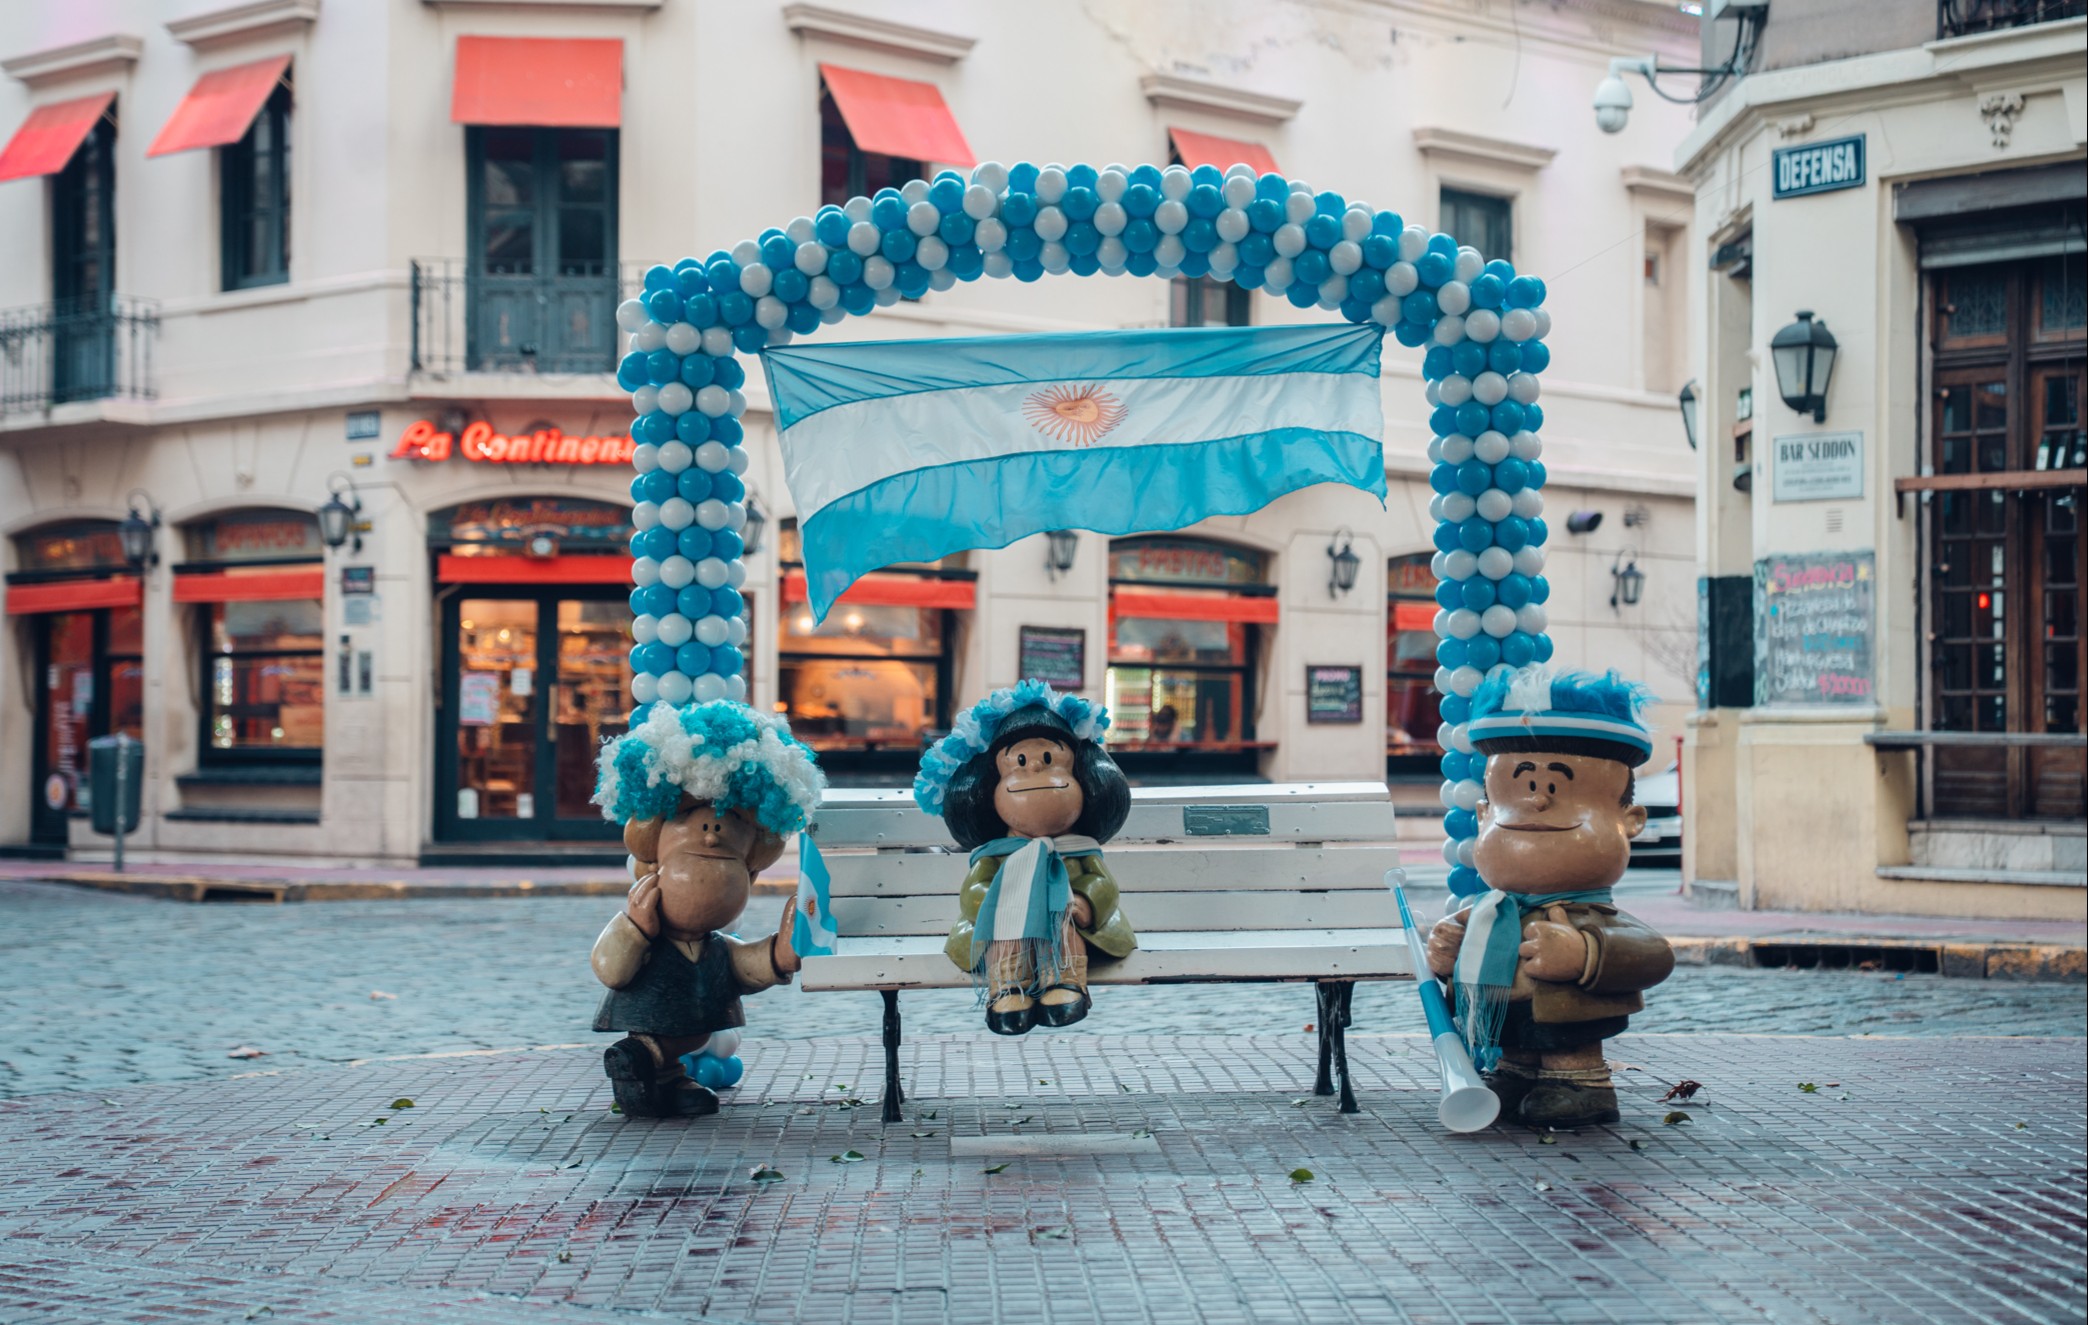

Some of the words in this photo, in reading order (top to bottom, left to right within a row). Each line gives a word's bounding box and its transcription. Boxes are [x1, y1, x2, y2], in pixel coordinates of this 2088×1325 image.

[1780, 142, 1856, 192] DEFENSA
[460, 420, 639, 464] Continent
[1780, 443, 1804, 463] BAR
[1808, 440, 1856, 460] SEDDON
[1138, 546, 1226, 577] PASTAS
